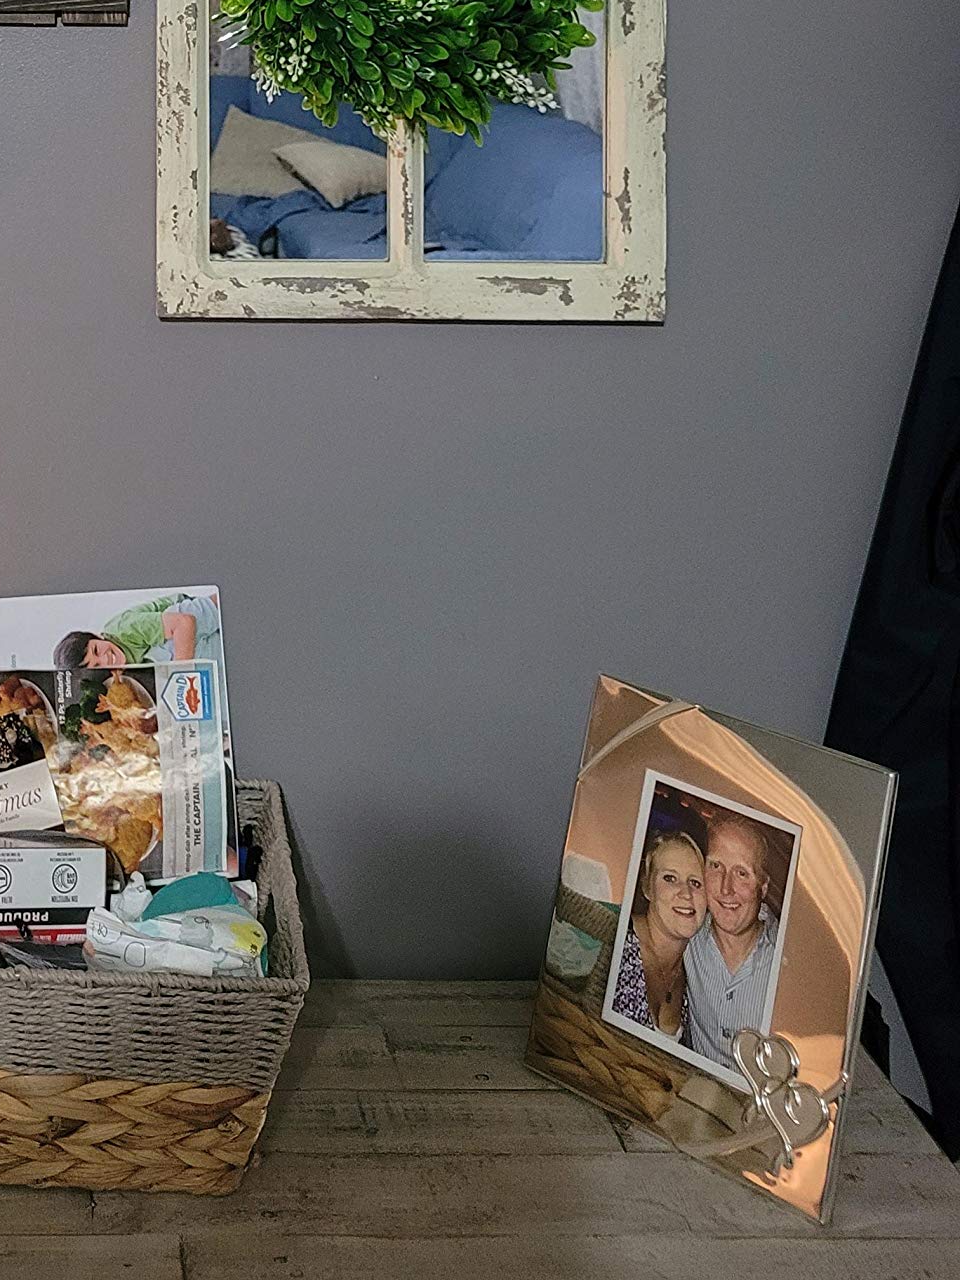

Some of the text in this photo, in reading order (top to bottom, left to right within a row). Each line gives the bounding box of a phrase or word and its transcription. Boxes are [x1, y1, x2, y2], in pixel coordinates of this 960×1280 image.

[56, 670, 65, 703] Butterfly
[64, 670, 72, 698] Shrimp
[176, 685, 189, 718] CAPTAIN
[191, 782, 201, 826] CAPTAIN
[193, 828, 202, 846] THE
